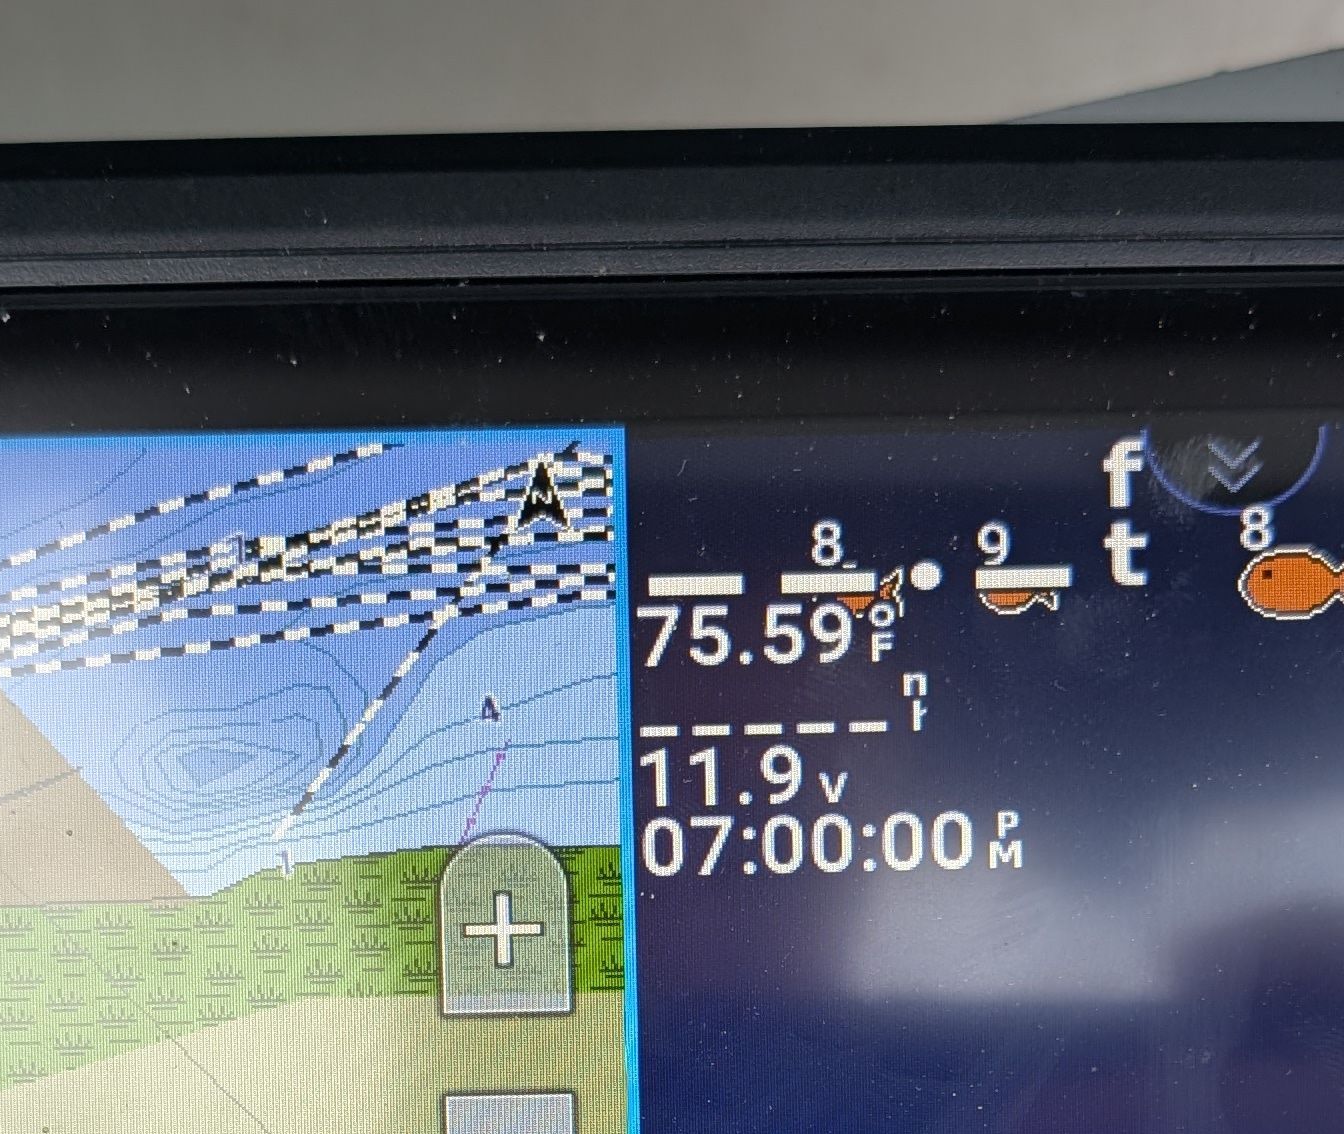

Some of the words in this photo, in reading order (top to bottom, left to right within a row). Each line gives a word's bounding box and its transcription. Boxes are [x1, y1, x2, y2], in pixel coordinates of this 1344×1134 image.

[811, 519, 843, 566] 8
[976, 519, 1011, 566] 9
[1240, 506, 1273, 549] 8
[636, 603, 853, 668] 75.59
[640, 744, 803, 807] 11.9
[641, 809, 974, 876] 07:00:00
